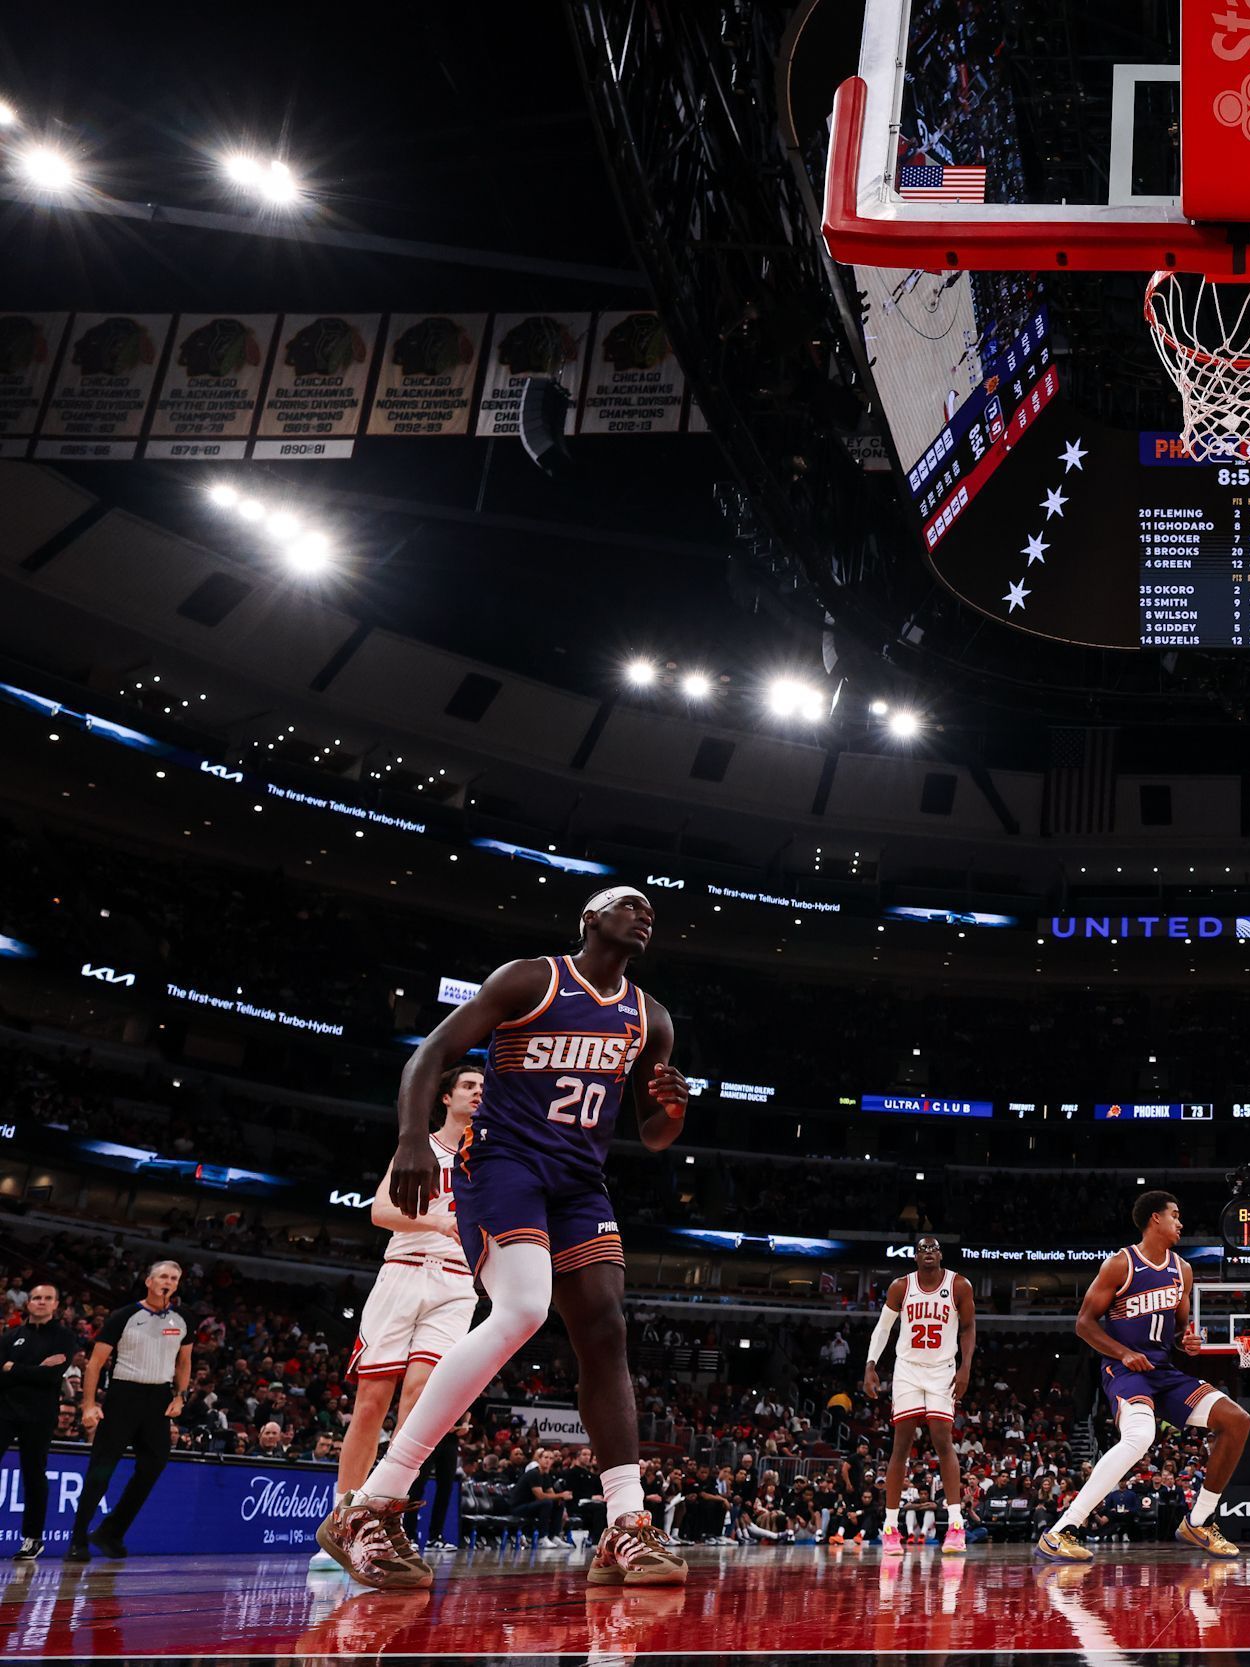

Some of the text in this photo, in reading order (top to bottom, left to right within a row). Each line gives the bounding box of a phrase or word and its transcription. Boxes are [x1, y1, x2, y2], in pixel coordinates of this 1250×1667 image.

[294, 377, 343, 387] CHICAGO
[403, 376, 451, 387] CHICAGO
[612, 373, 661, 383] CHICAGO
[599, 409, 664, 419] CHAMPIONS
[608, 422, 651, 431] 2012-13
[969, 424, 985, 460] 8:54
[1139, 509, 1203, 518] 20 FLEMING
[1140, 522, 1214, 531] 11 IGHODARO
[1140, 535, 1200, 544] 15 BOOKER
[1146, 547, 1199, 556] 3 BROOKS
[1145, 560, 1191, 569] 4 GREEN
[1139, 586, 1194, 594] 35 OKORO
[1140, 598, 1187, 607] 25 SMITH
[1146, 611, 1197, 620] 8 WILSON
[1146, 624, 1196, 632] 3 GIDDEY
[1140, 636, 1199, 645] 14 BUZELIS
[268, 784, 425, 833] The first-ever Telluride Turbo-Hybrid
[708, 885, 840, 912] The first-ever Telluride Turbo-Hybrid
[1051, 917, 1223, 938] UNITED
[167, 984, 343, 1036] The first-ever Telluride Turbo-Hybrid
[721, 1082, 754, 1094] EDMONTON
[547, 1076, 606, 1129] 20
[884, 1100, 970, 1113] ULTRA CLUB
[1134, 1106, 1203, 1118] PHOENIX 73
[961, 1248, 1117, 1260] The first-ever Telluride Turbo-Hyb
[907, 1302, 950, 1324] BULLS
[1149, 1314, 1164, 1342] 11
[911, 1324, 942, 1349] 25
[241, 1476, 329, 1521] Michelob
[263, 1530, 274, 1543] 26
